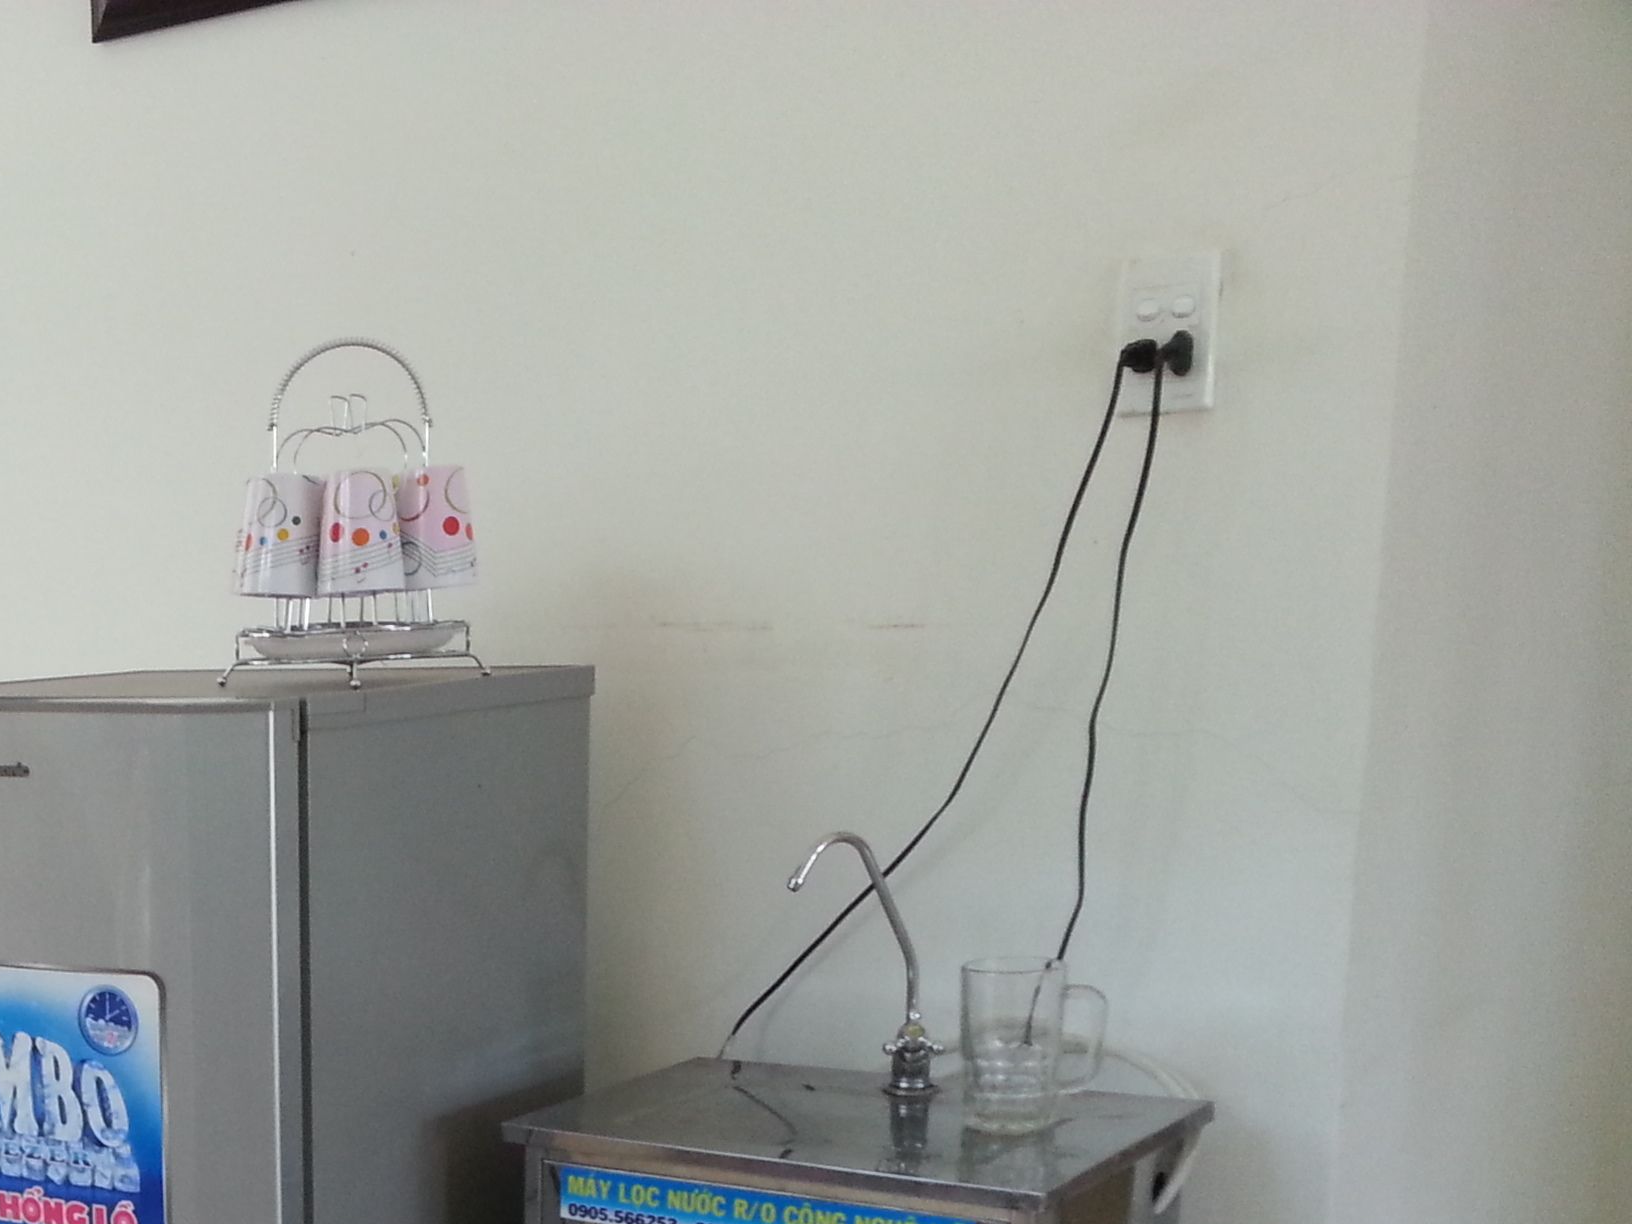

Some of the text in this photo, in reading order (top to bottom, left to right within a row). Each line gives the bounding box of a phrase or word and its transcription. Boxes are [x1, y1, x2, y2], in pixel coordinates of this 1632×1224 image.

[568, 1173, 611, 1200] MÁY
[619, 1182, 660, 1208] LỌC
[667, 1187, 727, 1217] NƯỚC
[733, 1198, 776, 1224] R/O
